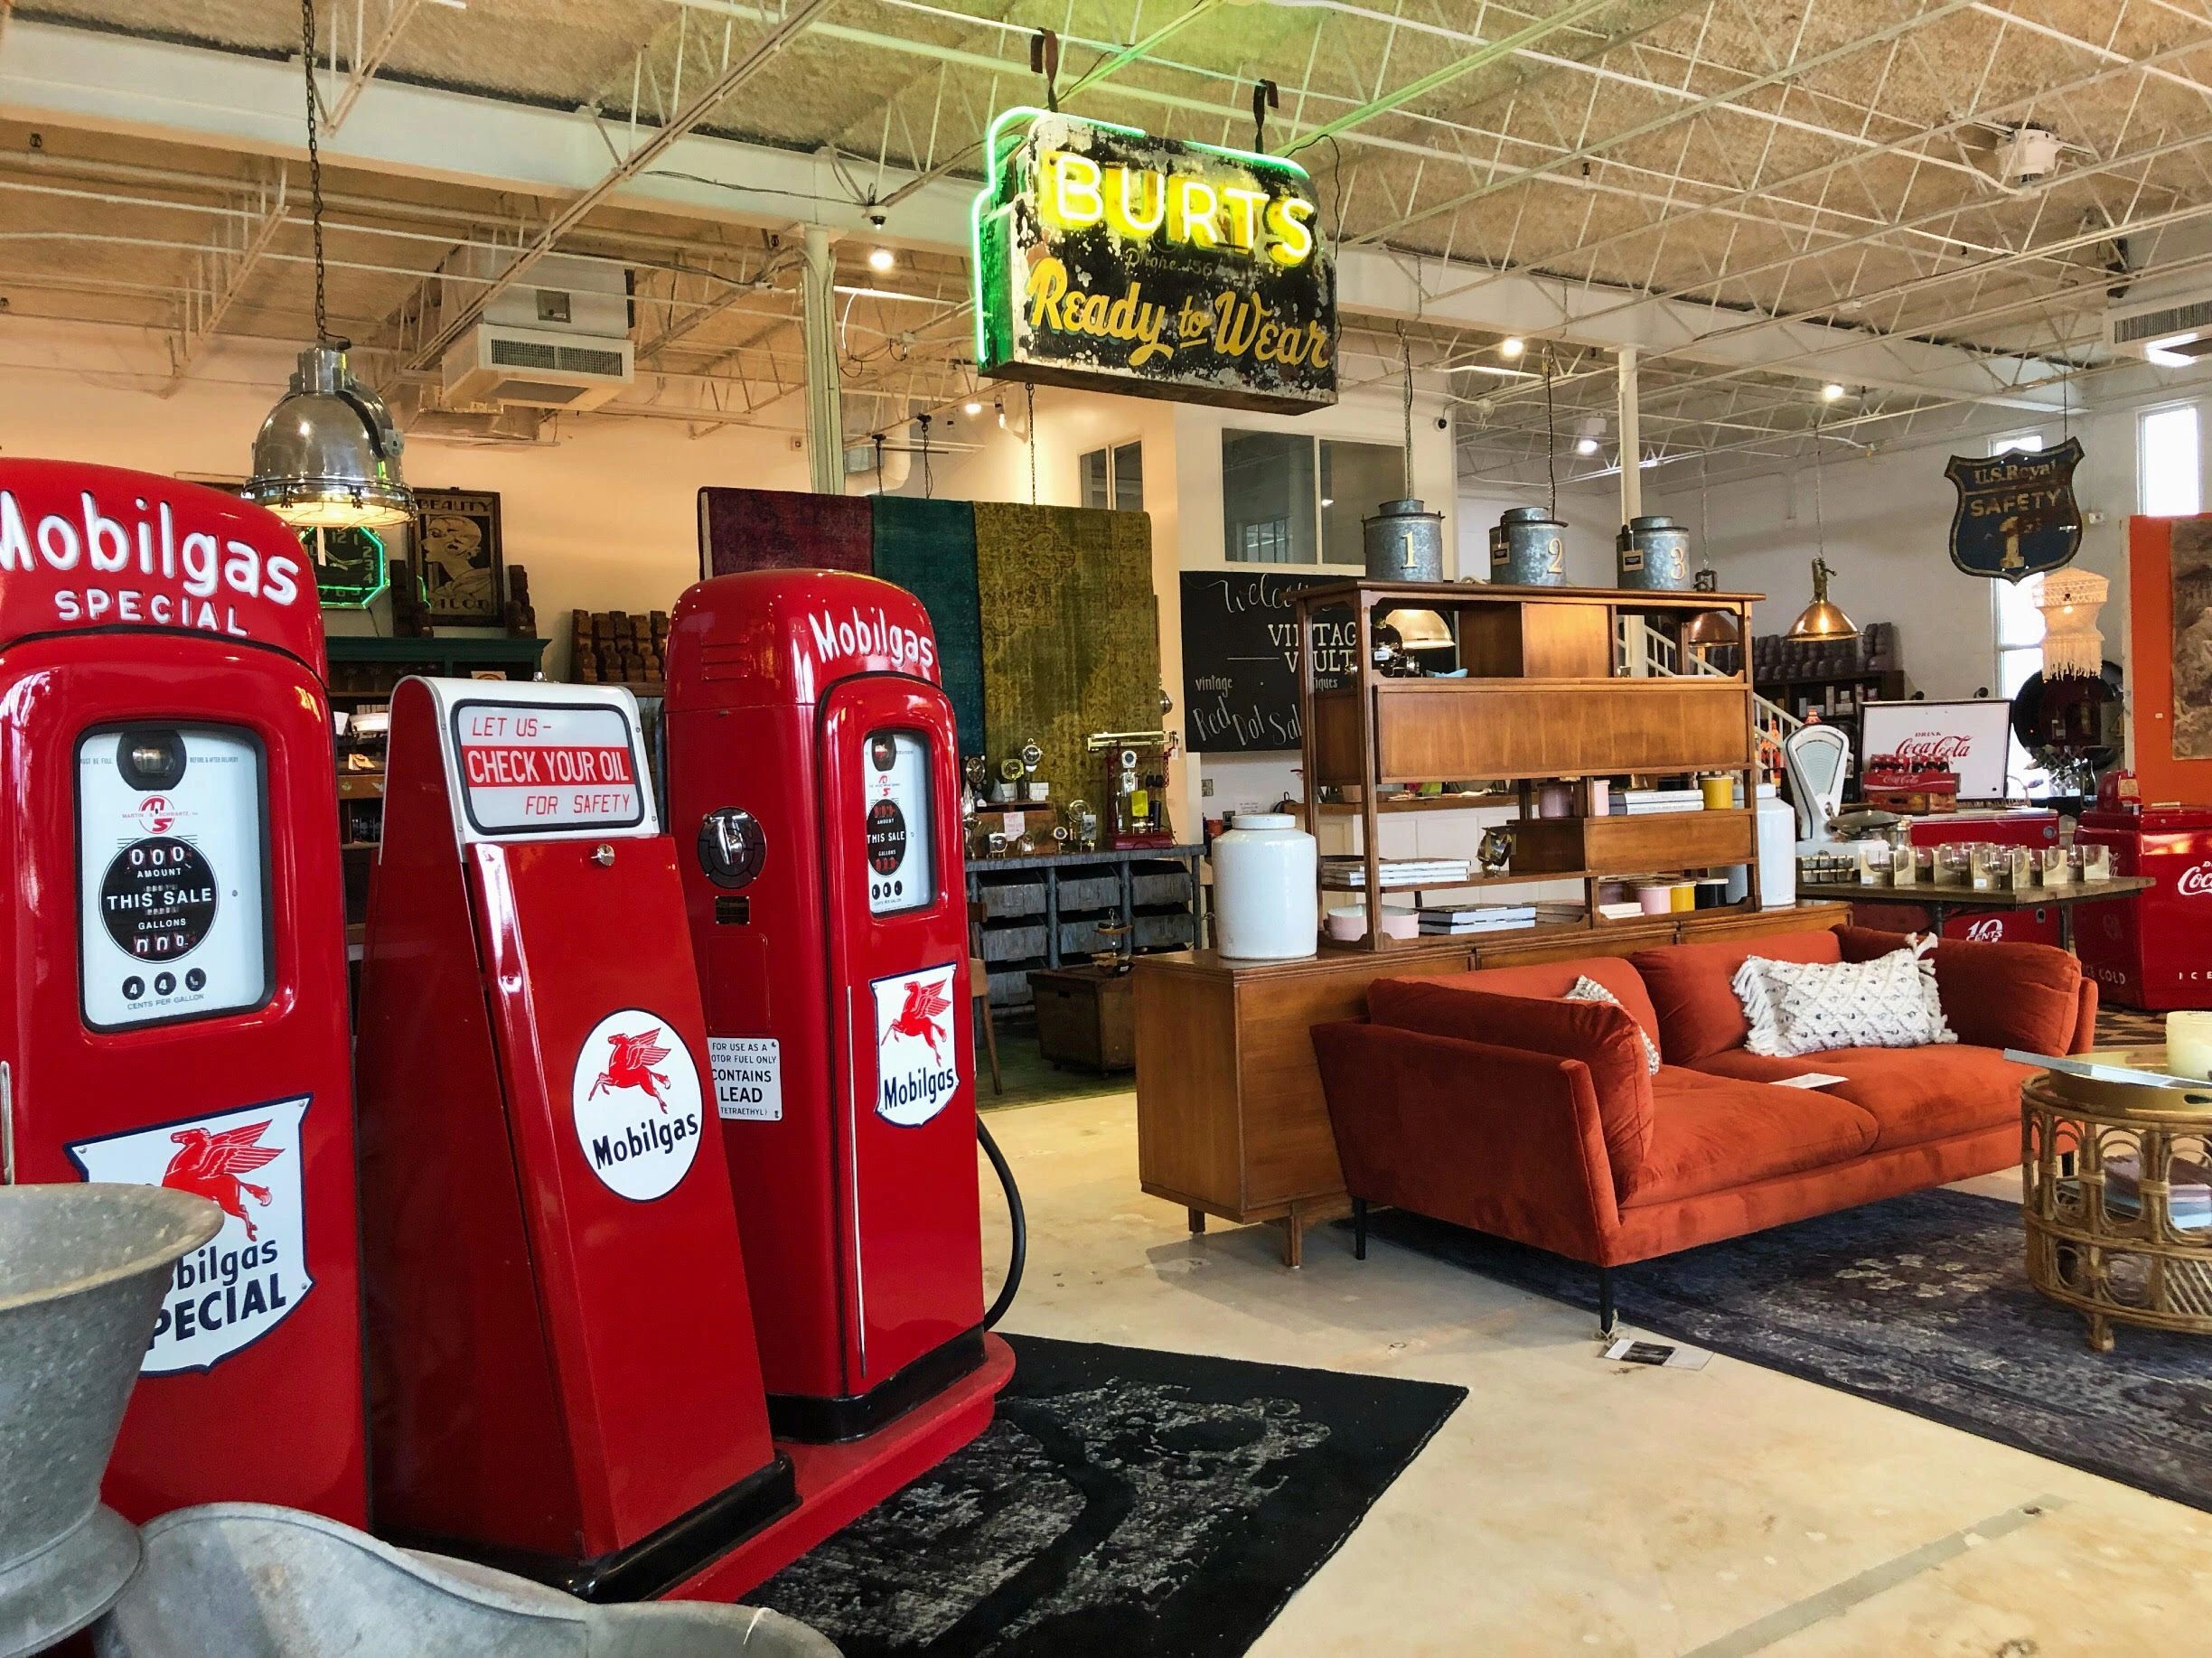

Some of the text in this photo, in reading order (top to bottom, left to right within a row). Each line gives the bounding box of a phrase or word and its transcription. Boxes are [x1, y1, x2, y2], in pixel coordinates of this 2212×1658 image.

[1039, 149, 1315, 267] BURTS
[1026, 257, 1333, 370] Ready to Wear
[417, 498, 493, 512] BEAUTY
[1970, 488, 2062, 517] SAFETY
[1401, 531, 1419, 569] 1
[1547, 538, 1563, 575] 2
[1670, 544, 1686, 581] 3
[54, 588, 248, 637] SPECIAL
[430, 597, 490, 613] ALON
[808, 606, 933, 668] Mobilgas
[1284, 649, 1355, 673] VULT
[1195, 675, 1233, 698] vintage
[472, 717, 507, 737] LET
[1193, 696, 1231, 742] Red
[1269, 704, 1302, 745] Sal
[467, 750, 629, 783] CHECK YOUR OIL
[525, 793, 631, 815] FOR SAFETY
[867, 830, 905, 845] THIS SALE
[136, 867, 182, 878] AMOUNT
[107, 893, 154, 910] THIS
[164, 887, 212, 905] SALE
[137, 917, 186, 931] GALLONS
[127, 993, 205, 1011] CENTS PER GALLON
[711, 1054, 777, 1064] OTOR FUEL ONLY
[712, 1042, 768, 1052] FOR USE AS A
[720, 1086, 764, 1103] LEAD
[884, 1067, 954, 1110] Mobilgas
[592, 1112, 698, 1170] Mobilgas
[166, 1239, 278, 1295] bilgas
[147, 1272, 286, 1351] PECIAL
